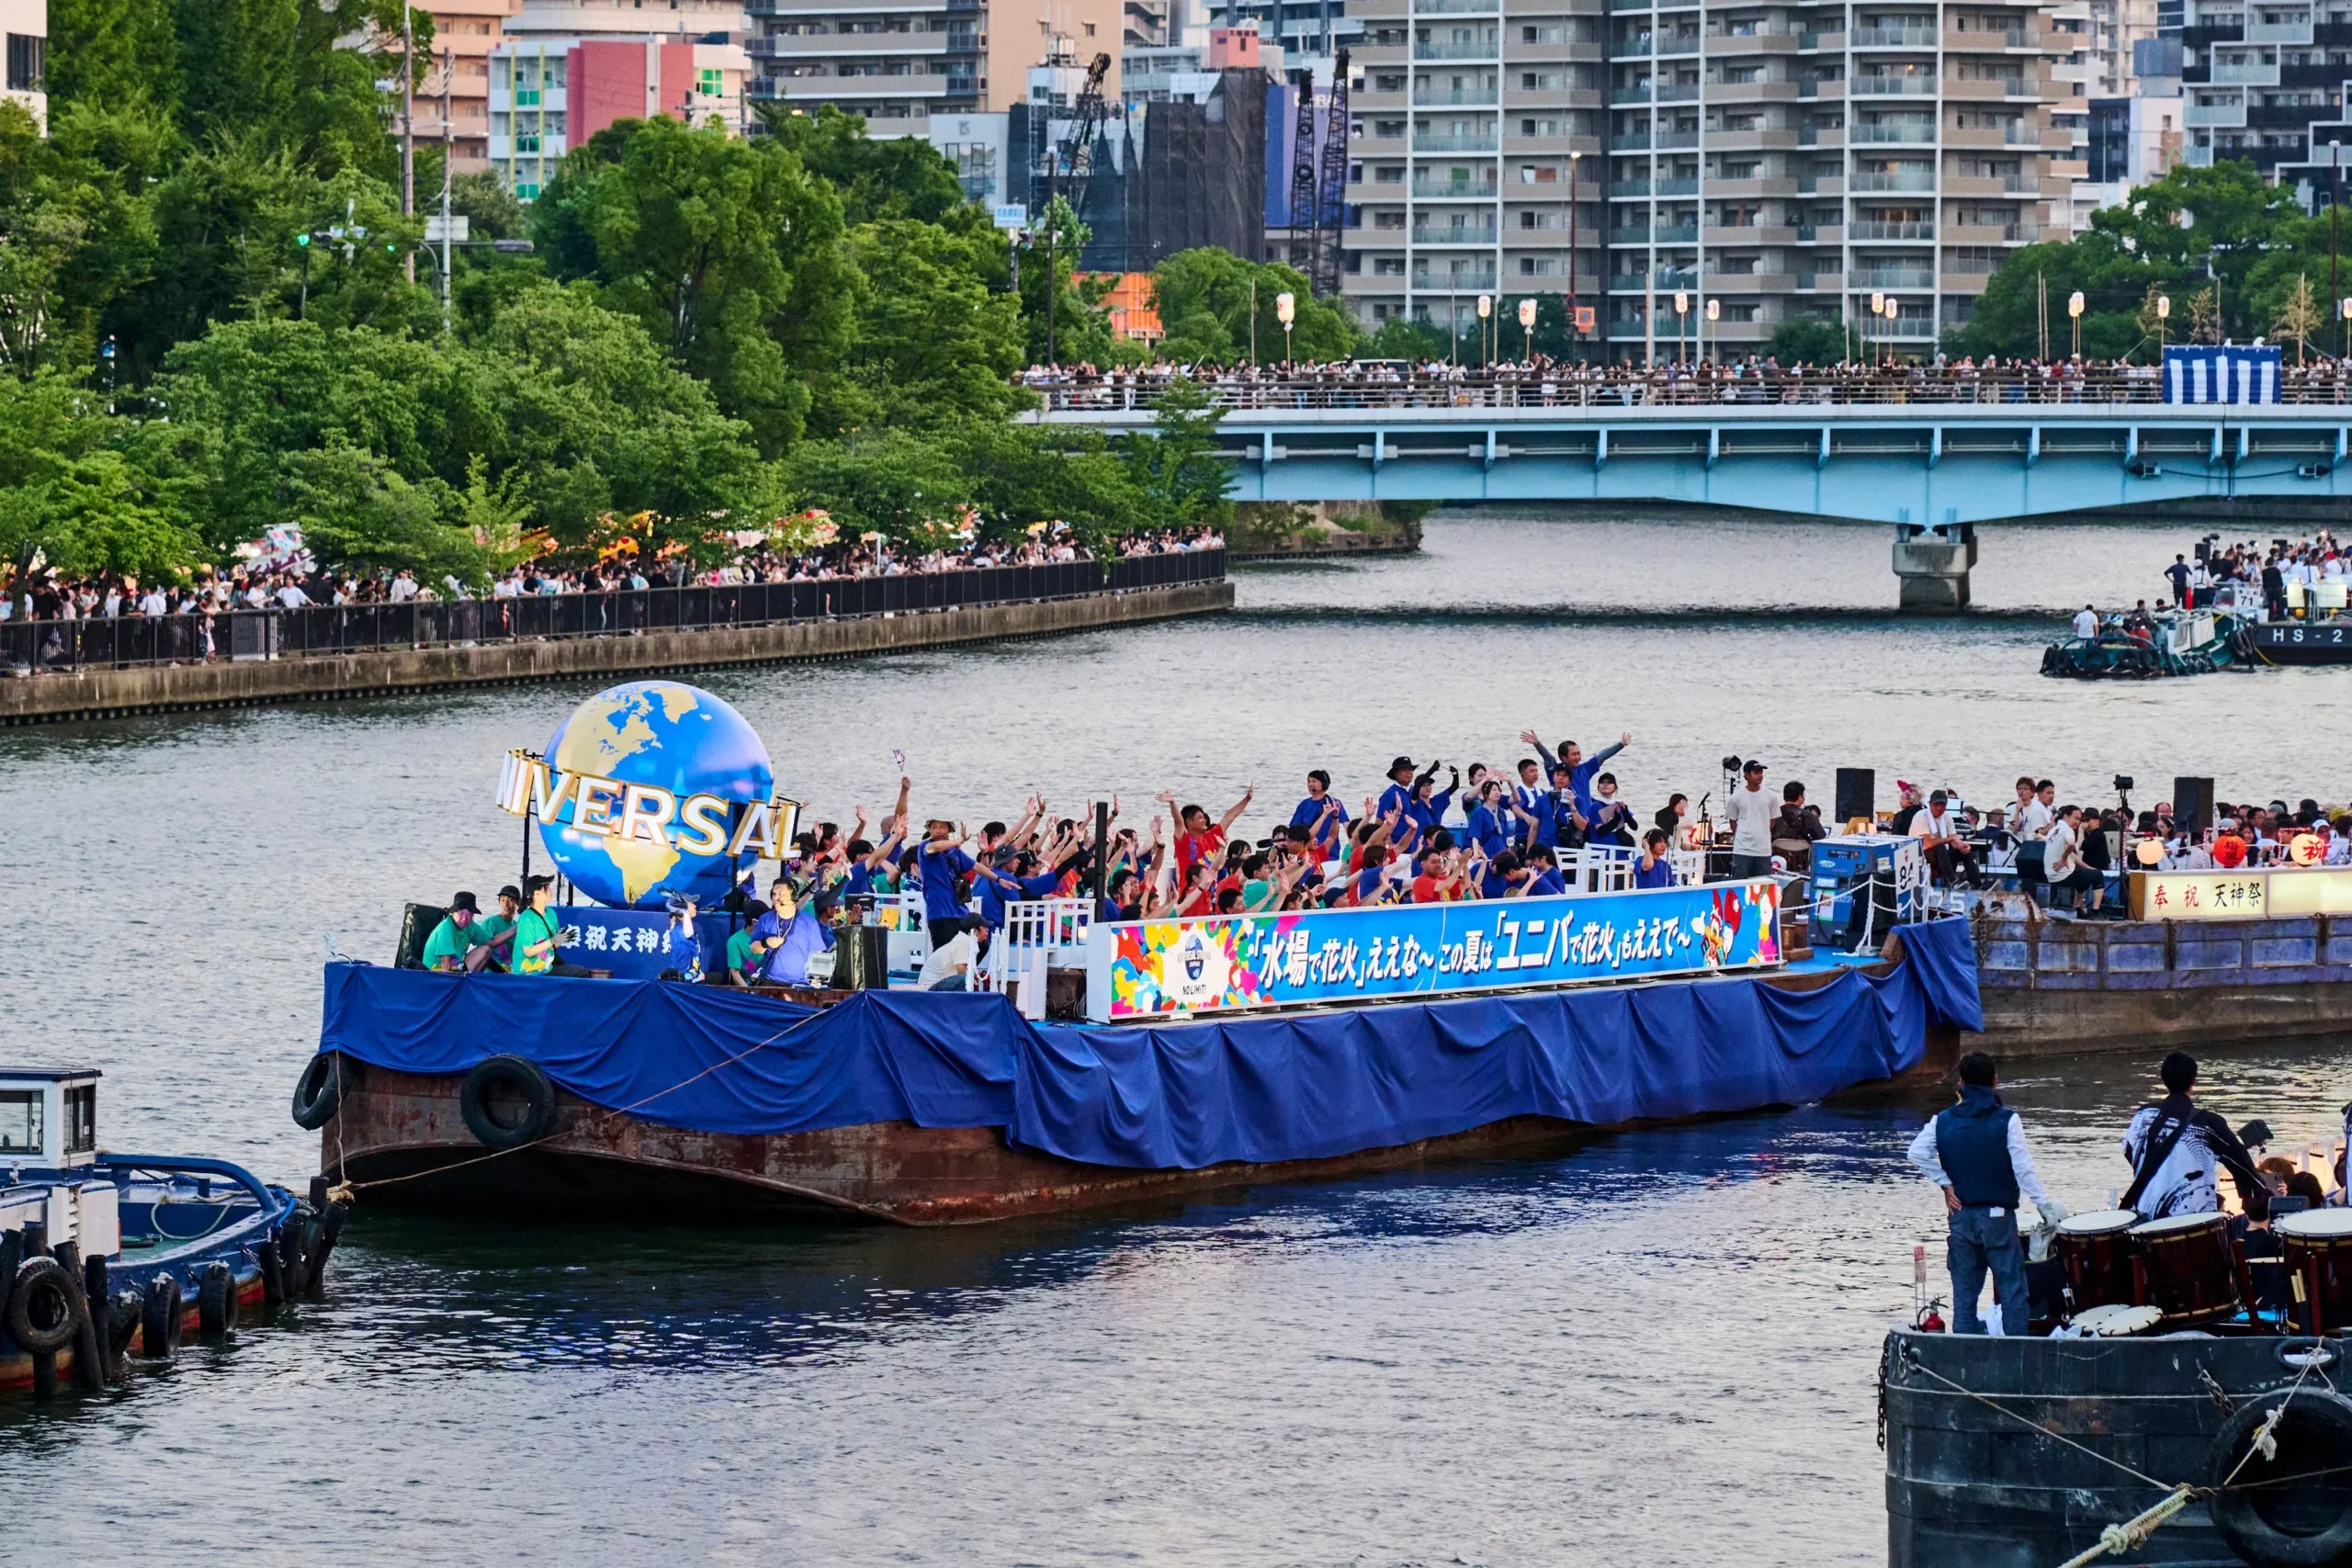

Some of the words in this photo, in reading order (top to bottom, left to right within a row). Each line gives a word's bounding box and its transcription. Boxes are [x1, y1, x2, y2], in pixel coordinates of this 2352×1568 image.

[2241, 595, 2254, 606] 71
[2302, 839, 2324, 860] 祝
[2213, 881, 2262, 908] 天神祭
